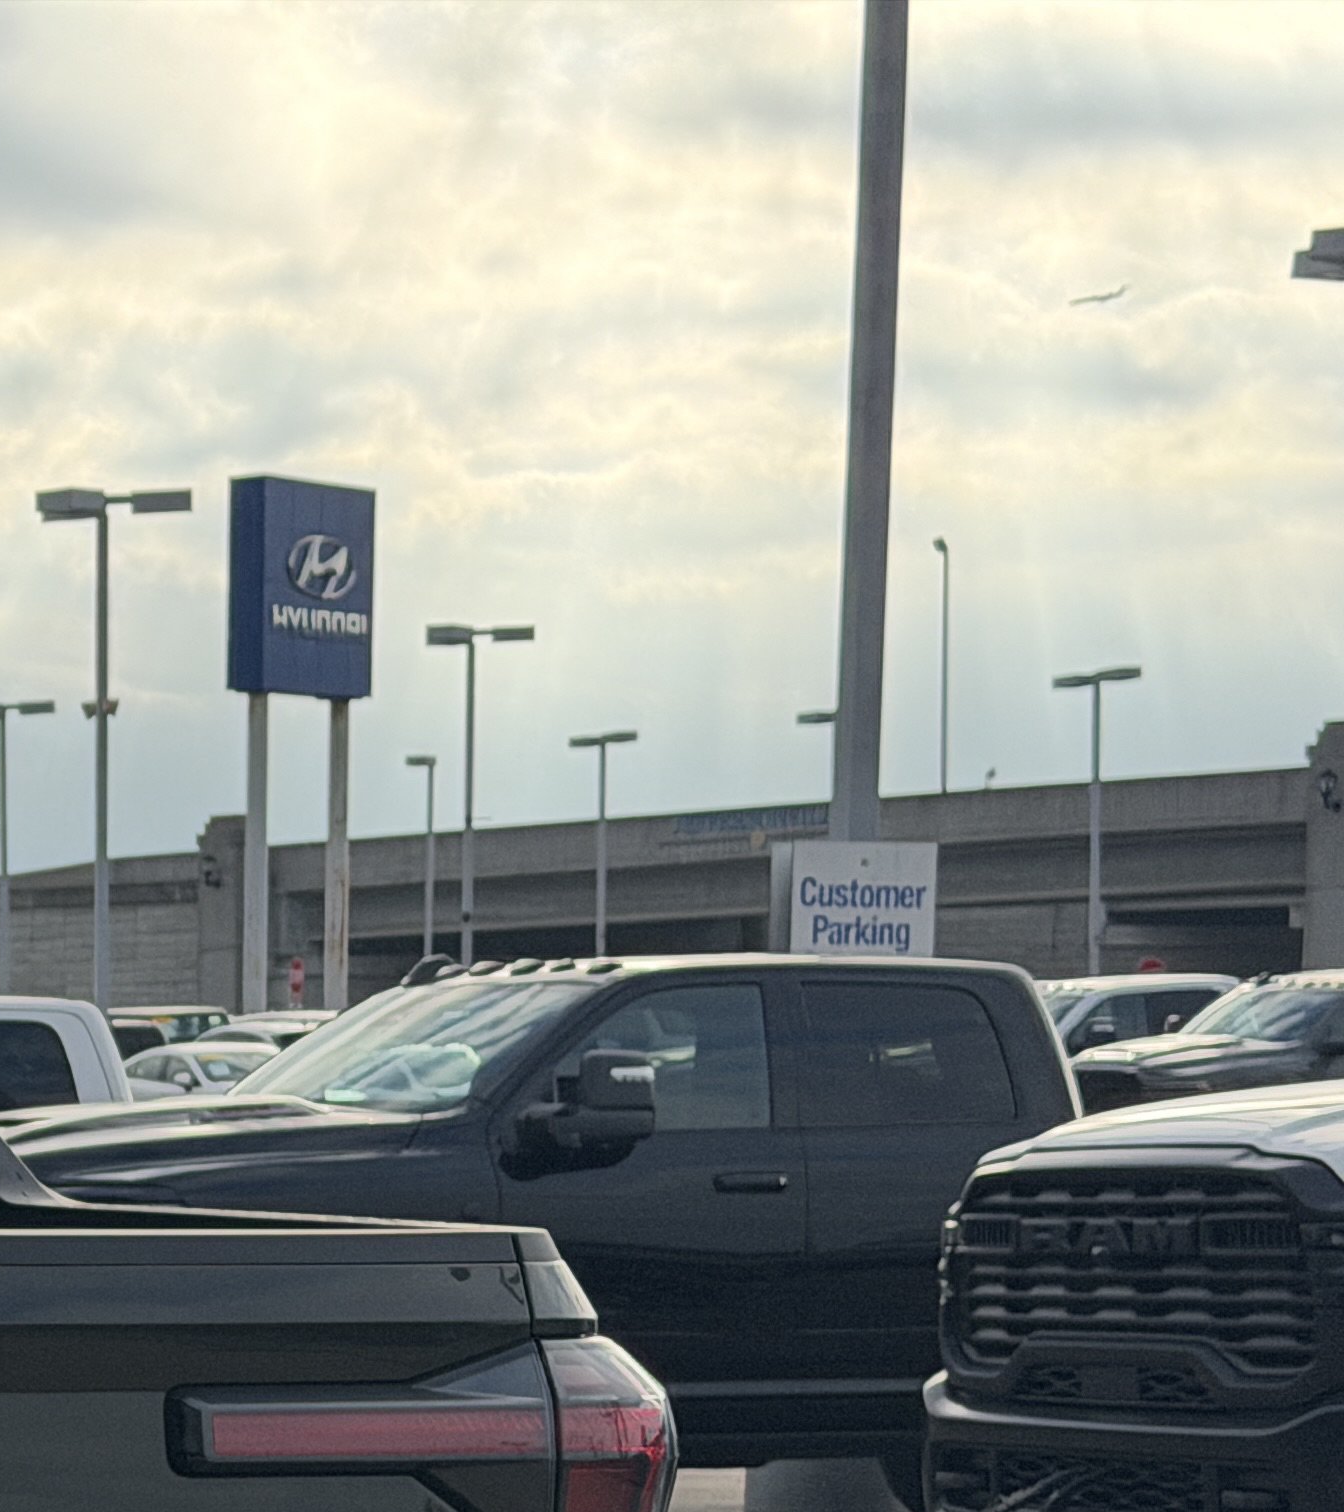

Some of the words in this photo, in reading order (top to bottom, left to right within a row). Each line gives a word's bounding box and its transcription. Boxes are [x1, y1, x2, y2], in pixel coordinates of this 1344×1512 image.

[272, 603, 368, 635] HYUNDAI
[800, 876, 928, 909] Customer
[812, 914, 911, 952] Parking
[1020, 1216, 1197, 1254] RAM
